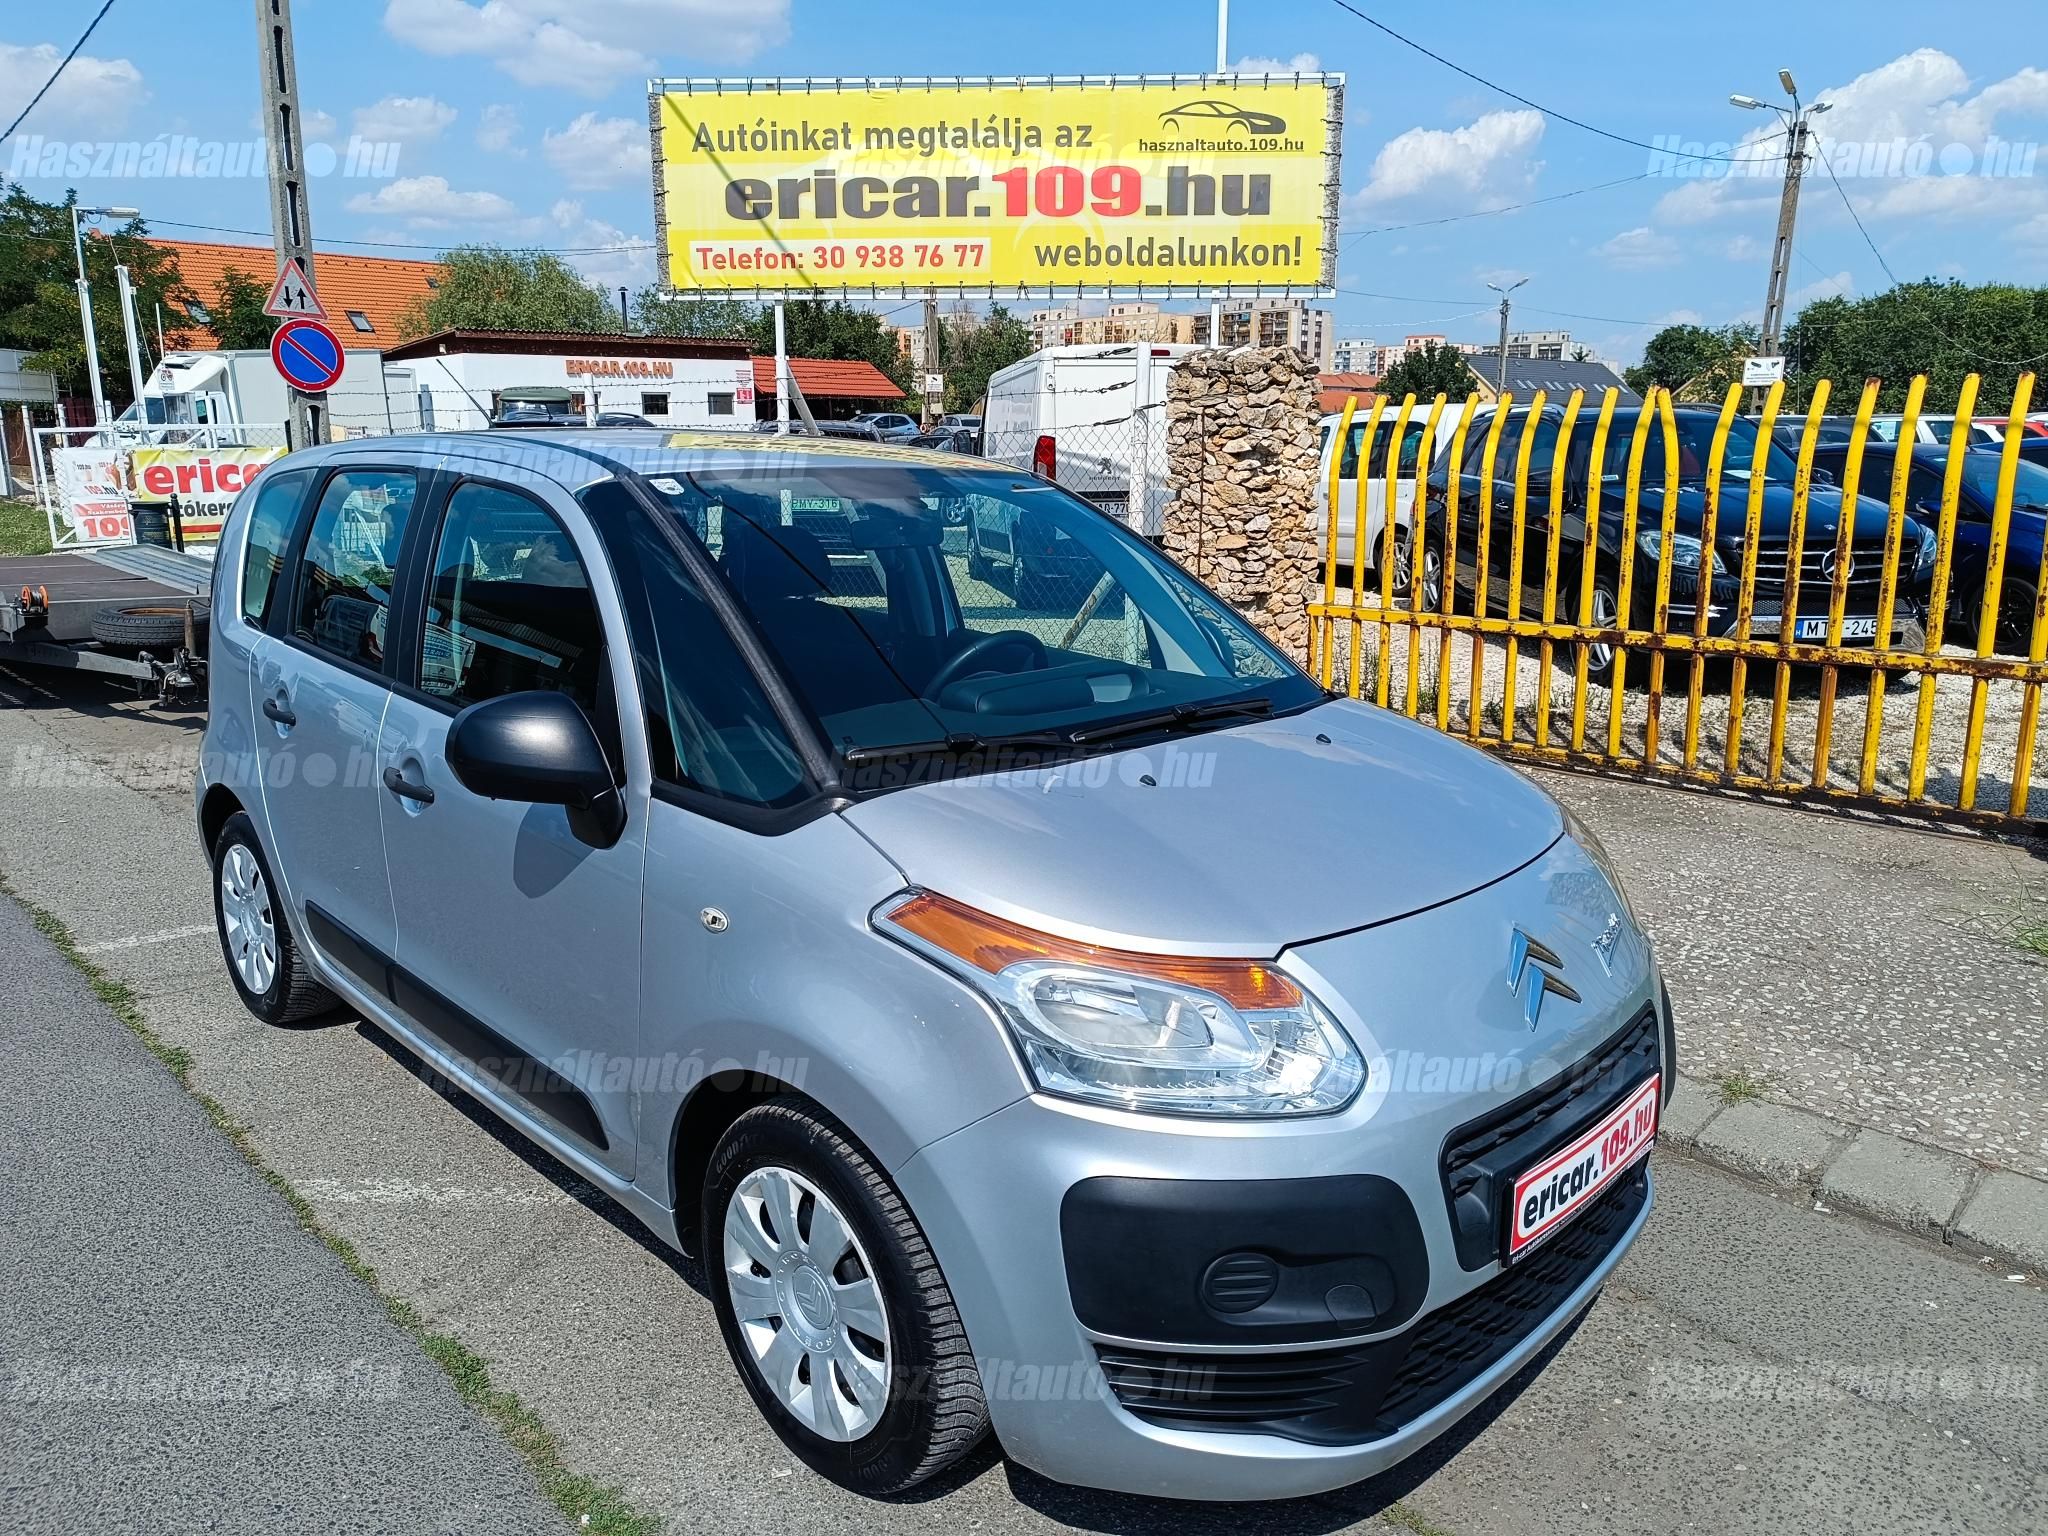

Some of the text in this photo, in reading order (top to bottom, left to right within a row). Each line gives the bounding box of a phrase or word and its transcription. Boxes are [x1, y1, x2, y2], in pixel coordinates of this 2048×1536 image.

[692, 114, 1093, 157] Autóinkat megtalálja az
[1138, 138, 1304, 152] hasznaltauto.109.hu
[725, 164, 1272, 220] ericar.109.hu
[696, 244, 984, 271] Telefon: 30 938 76 77
[1034, 235, 1302, 267] weboldalunkon!
[565, 360, 673, 379] ERICAR.109.HU
[85, 485, 118, 495] 109.hu
[1806, 620, 1877, 636] MT-245
